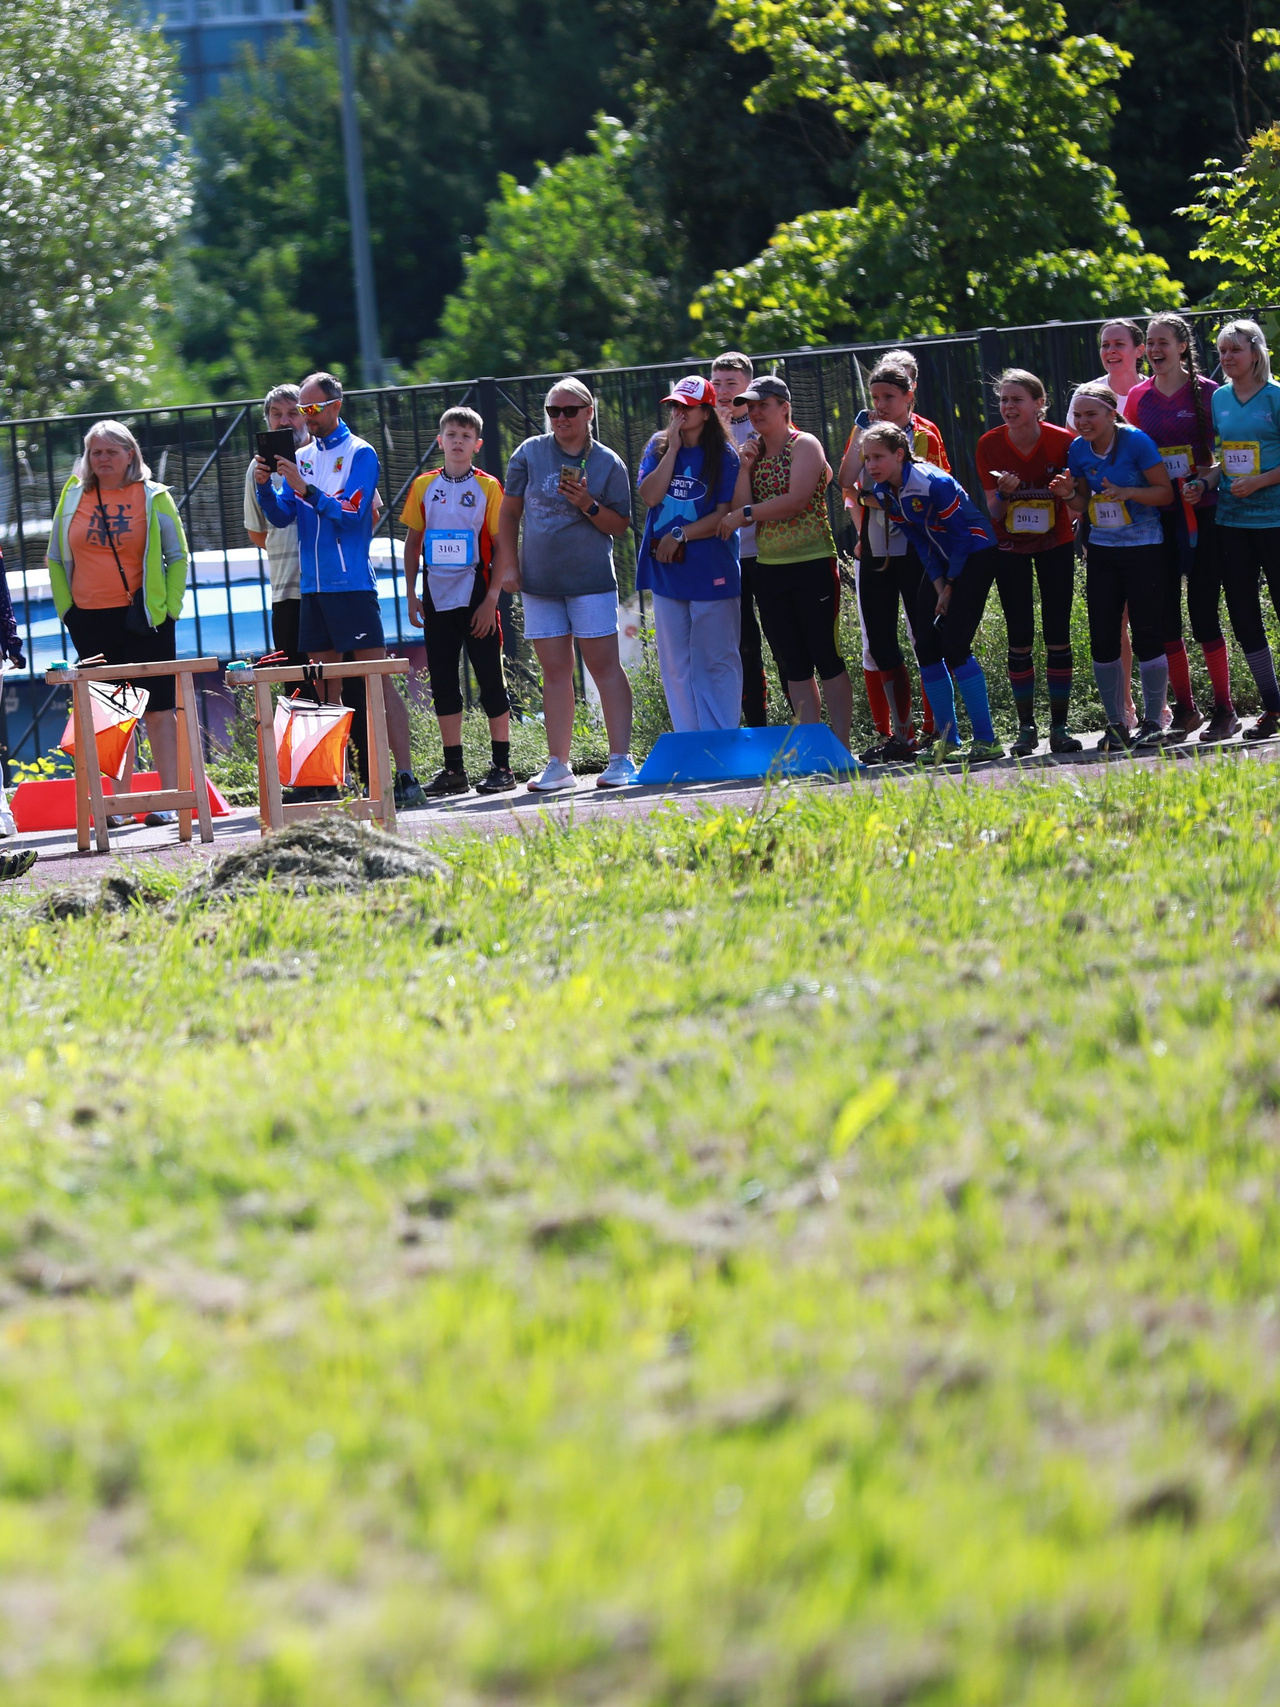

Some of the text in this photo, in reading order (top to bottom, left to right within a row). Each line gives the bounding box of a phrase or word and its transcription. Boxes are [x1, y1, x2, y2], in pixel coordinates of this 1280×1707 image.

[1228, 454, 1248, 463] 231.2
[1163, 460, 1181, 470] 31.1
[1017, 515, 1039, 523] 201.2
[438, 544, 461, 553] 310.3
